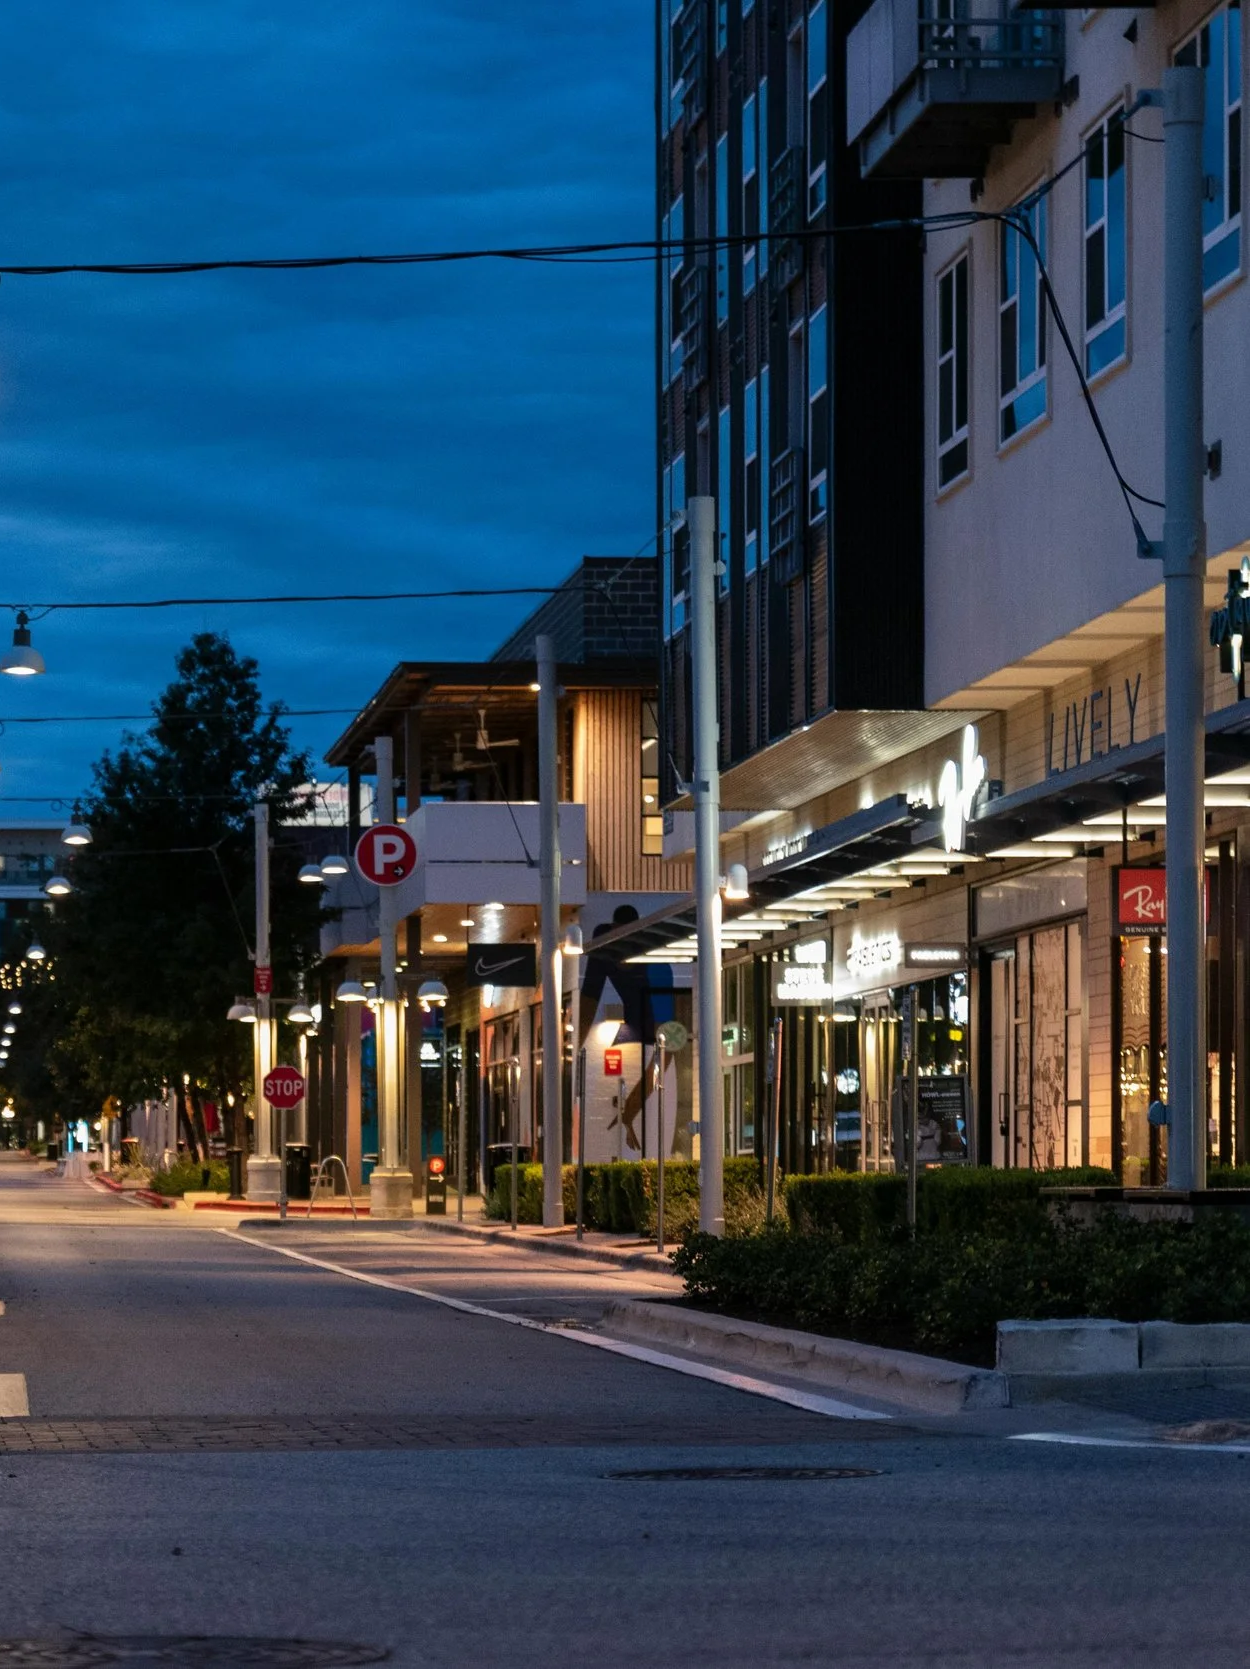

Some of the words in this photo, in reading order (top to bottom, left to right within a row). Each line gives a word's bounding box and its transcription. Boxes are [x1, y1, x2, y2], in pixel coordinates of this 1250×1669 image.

[1048, 672, 1141, 776] LIVELY
[373, 834, 406, 875] P
[264, 1079, 303, 1097] STOP
